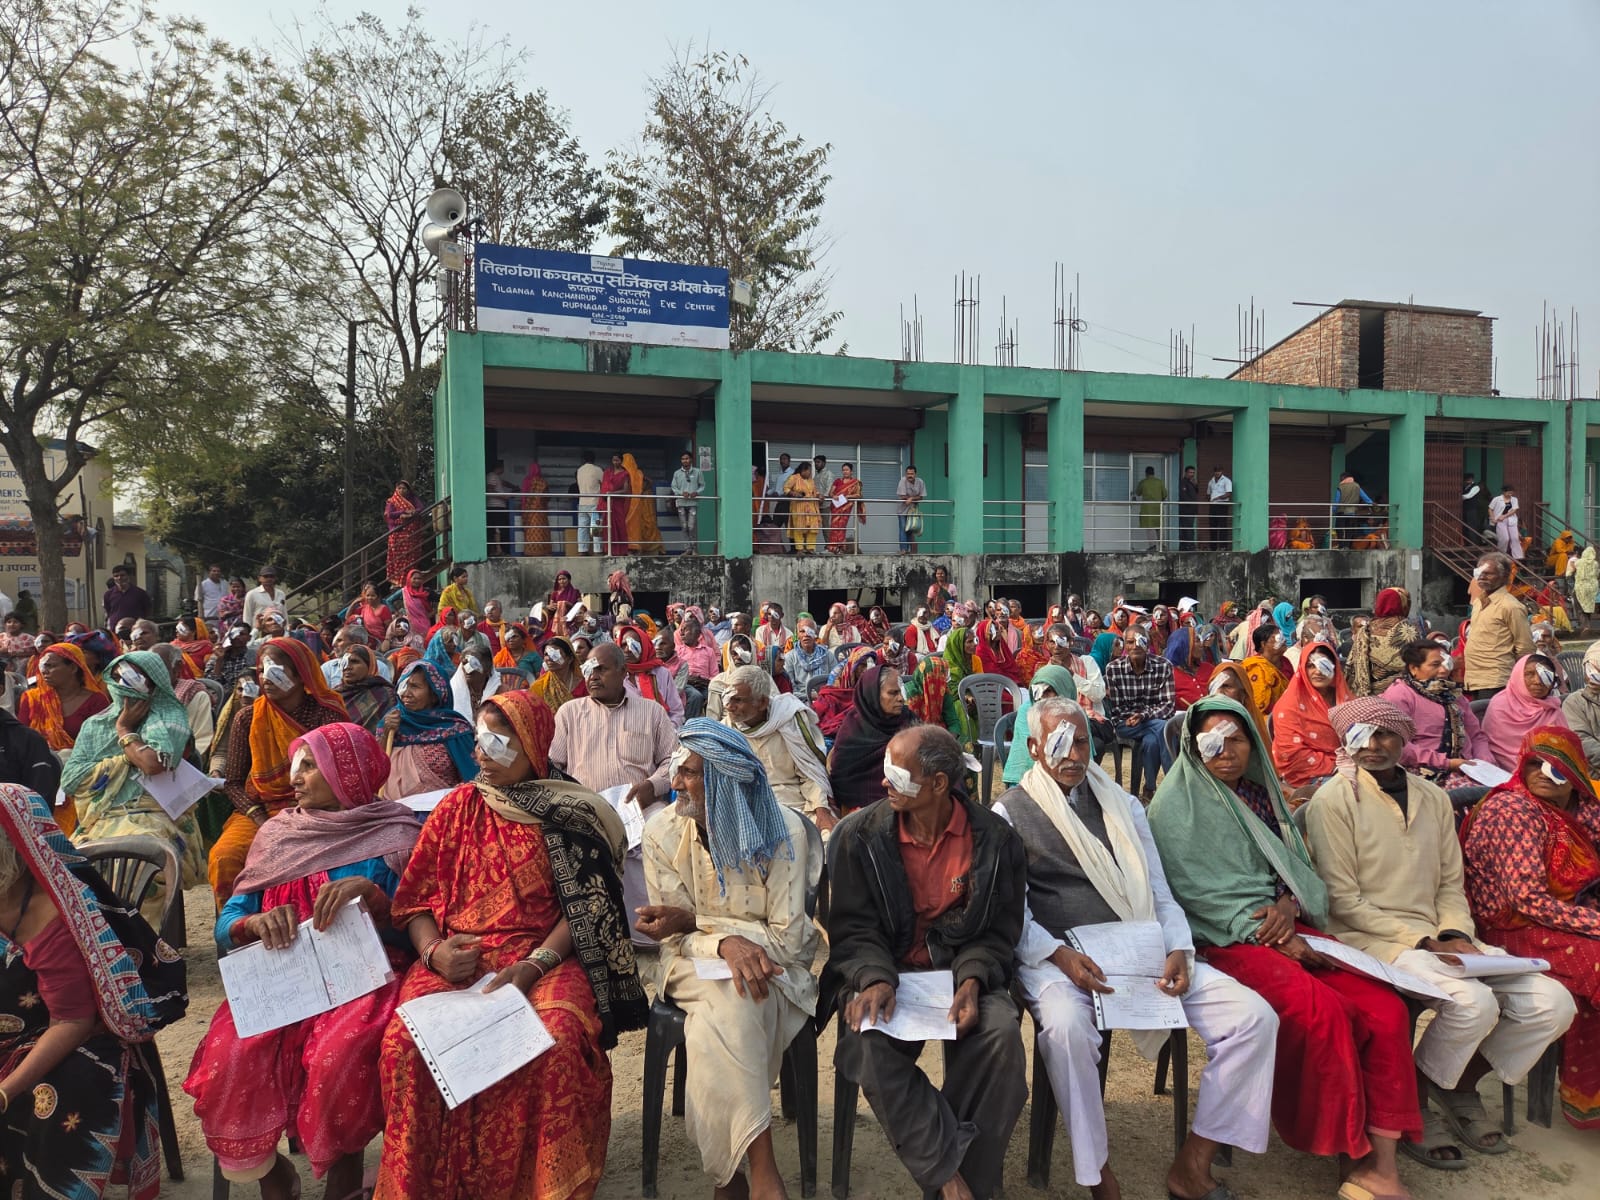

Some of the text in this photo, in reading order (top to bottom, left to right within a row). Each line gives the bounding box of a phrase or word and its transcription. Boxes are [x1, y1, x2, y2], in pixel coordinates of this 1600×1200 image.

[479, 258, 541, 279] तिलगंगा
[491, 282, 716, 312] TILGANGA KANCHANRUP SURGICAL EYE CENTRE
[617, 306, 651, 315] SAPTARI
